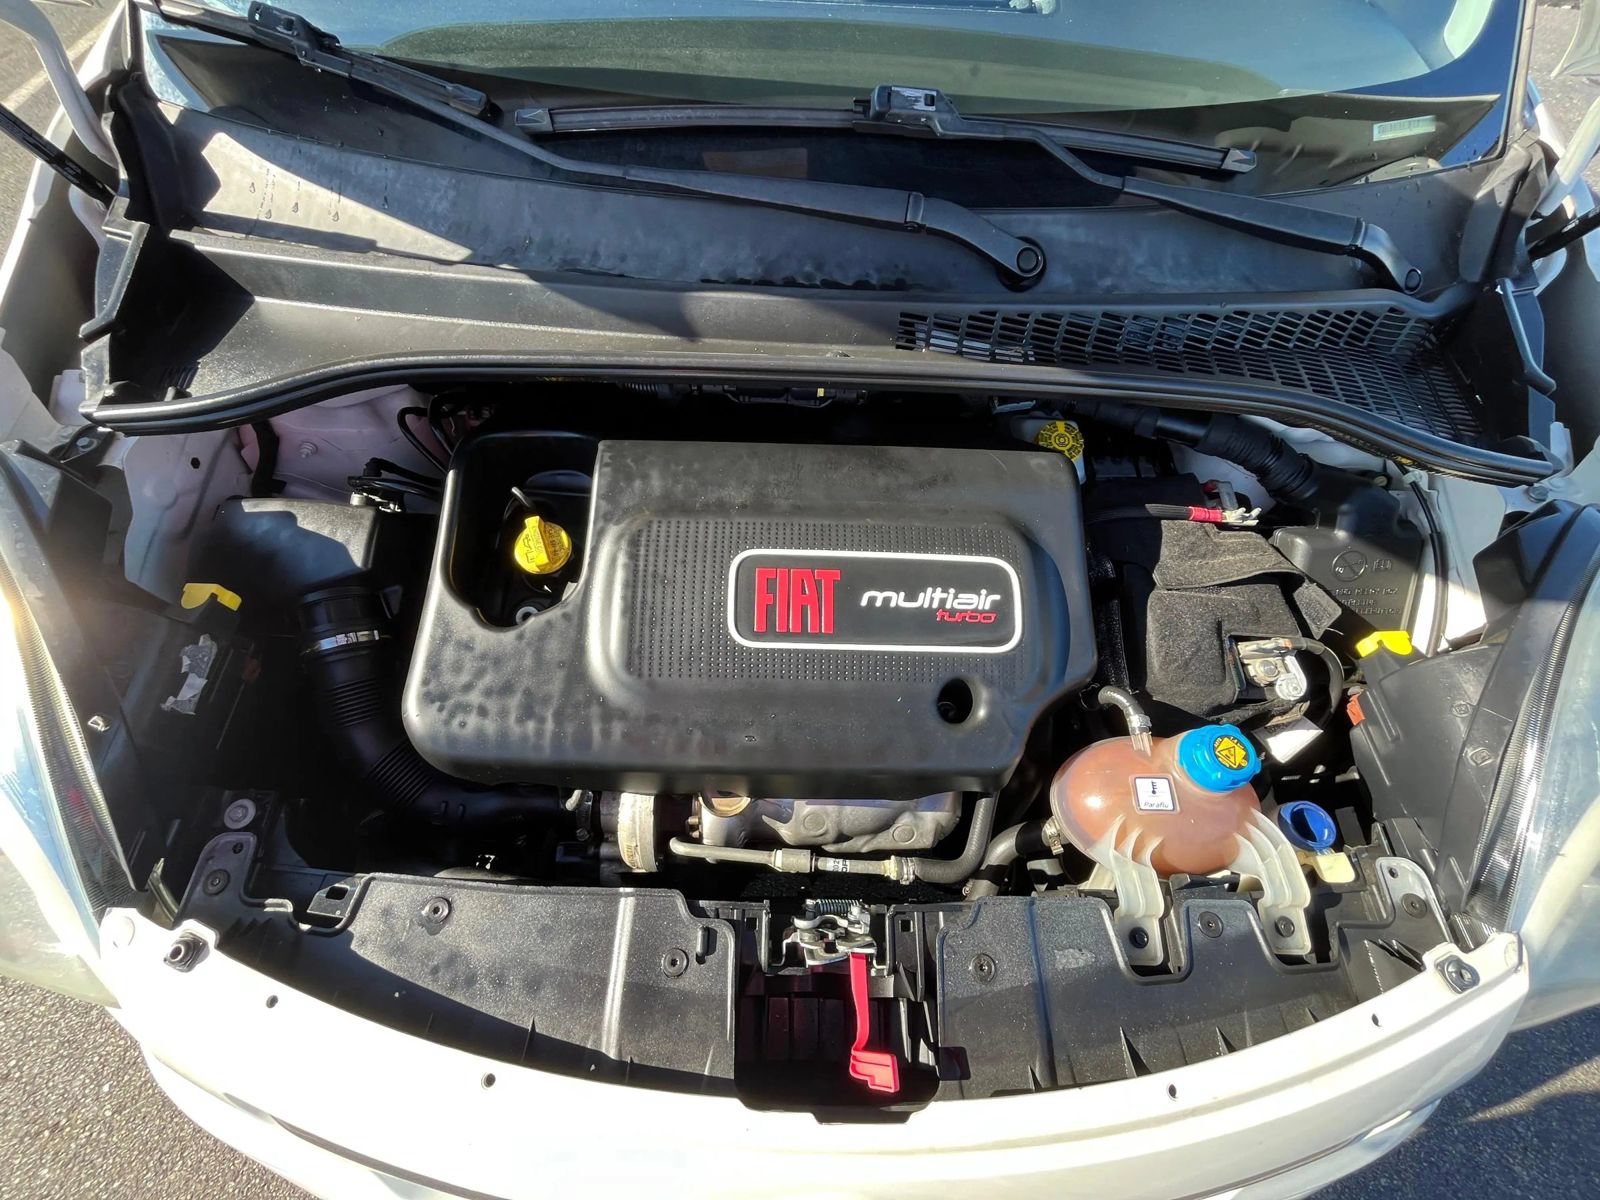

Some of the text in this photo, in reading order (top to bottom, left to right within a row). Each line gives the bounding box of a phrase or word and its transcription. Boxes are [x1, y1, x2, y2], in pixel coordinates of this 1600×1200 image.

[754, 567, 841, 634] FIAT
[860, 587, 1001, 611] multiair
[936, 609, 997, 624] turbo
[1143, 801, 1169, 809] Paraflu
